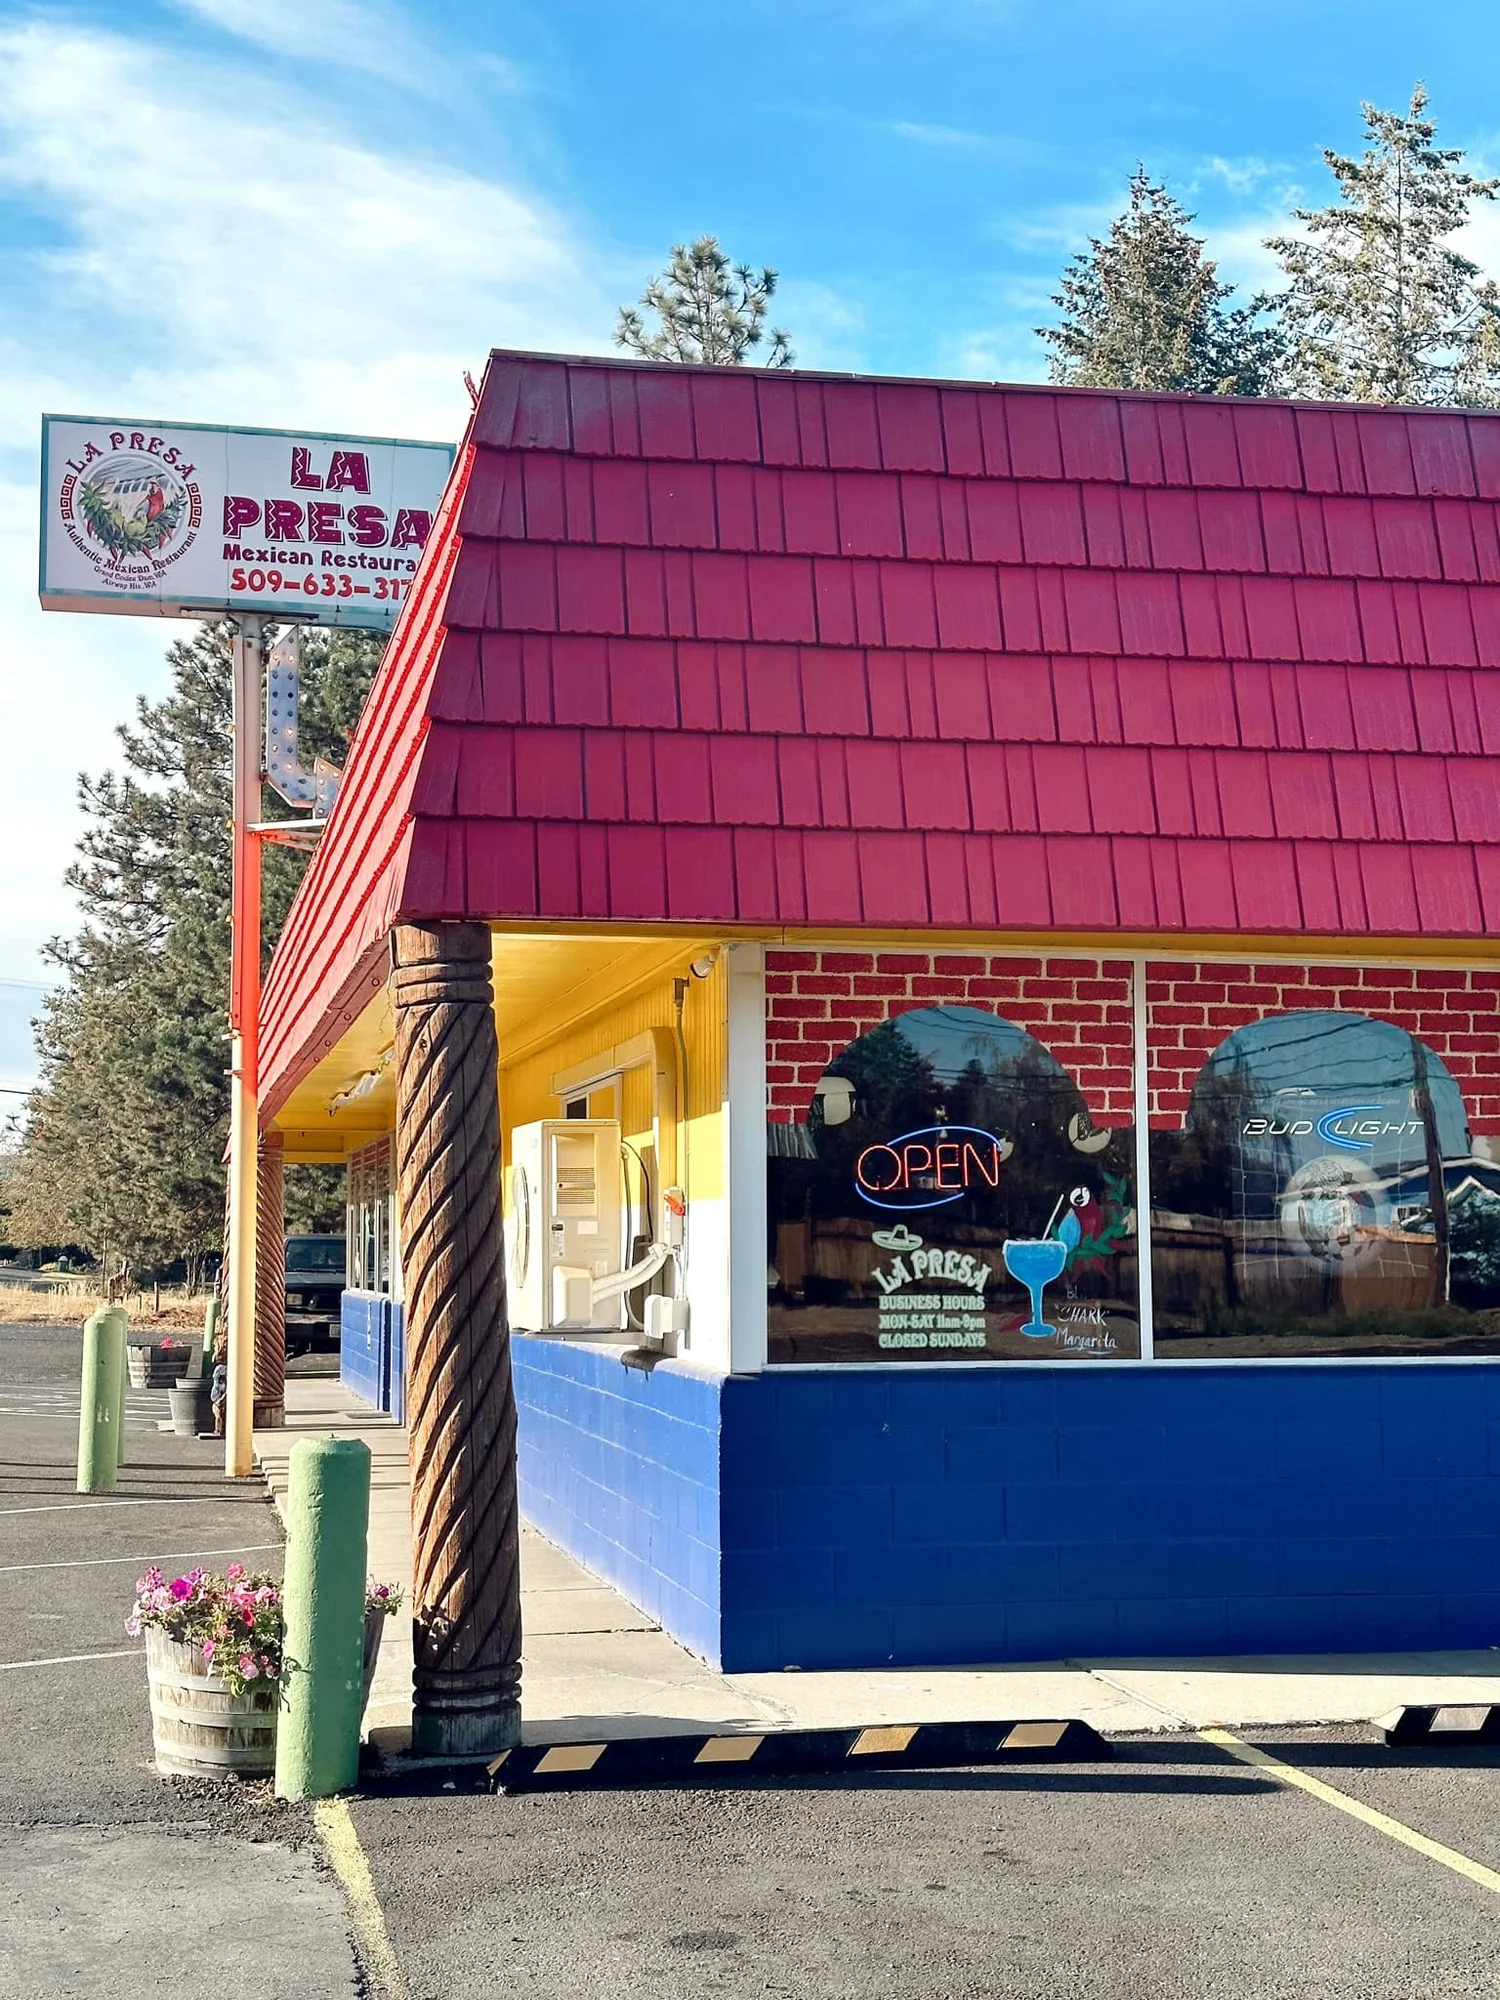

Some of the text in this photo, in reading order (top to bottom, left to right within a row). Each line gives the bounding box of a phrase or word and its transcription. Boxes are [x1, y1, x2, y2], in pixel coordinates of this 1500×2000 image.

[66, 431, 198, 481] LA PRESA
[290, 446, 371, 495] LA
[222, 495, 434, 550] PRESA
[63, 522, 198, 574] Authentic Mexican Restaurant
[222, 543, 417, 572] Mexican Restaura
[93, 565, 114, 579] Grand
[101, 578, 128, 590] Airway
[230, 567, 413, 601] 509-633-317
[1242, 1118, 1425, 1136] BUD LIGHT
[857, 1143, 999, 1190] OPEN
[871, 1248, 992, 1294] LA PRESA
[878, 1294, 985, 1310] BUSINESS HOURS
[878, 1313, 986, 1331] MON-SAT 11am-9pm
[878, 1332, 987, 1348] CLOSED SUNDAYS
[1056, 1326, 1118, 1350] Margarita
